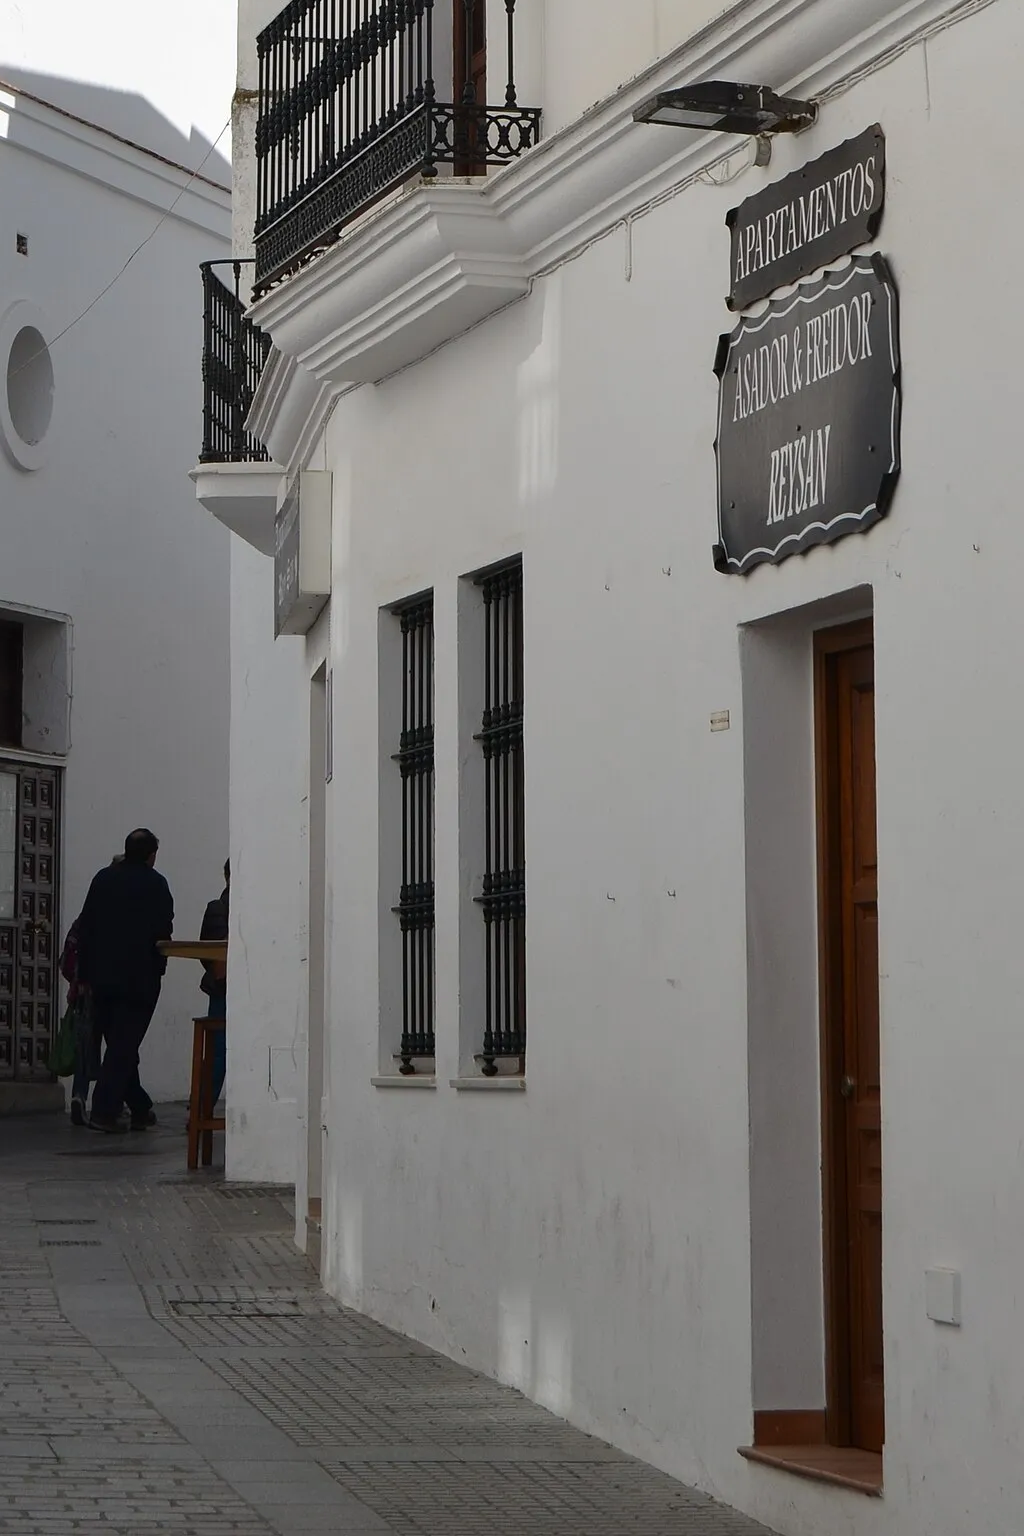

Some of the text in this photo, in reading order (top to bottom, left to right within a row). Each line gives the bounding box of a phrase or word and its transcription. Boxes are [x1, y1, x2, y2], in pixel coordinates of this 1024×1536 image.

[735, 156, 875, 283] APARTAMENTOS
[733, 291, 873, 423] ASADOR & FREIDOR
[766, 424, 831, 526] REYSAN
